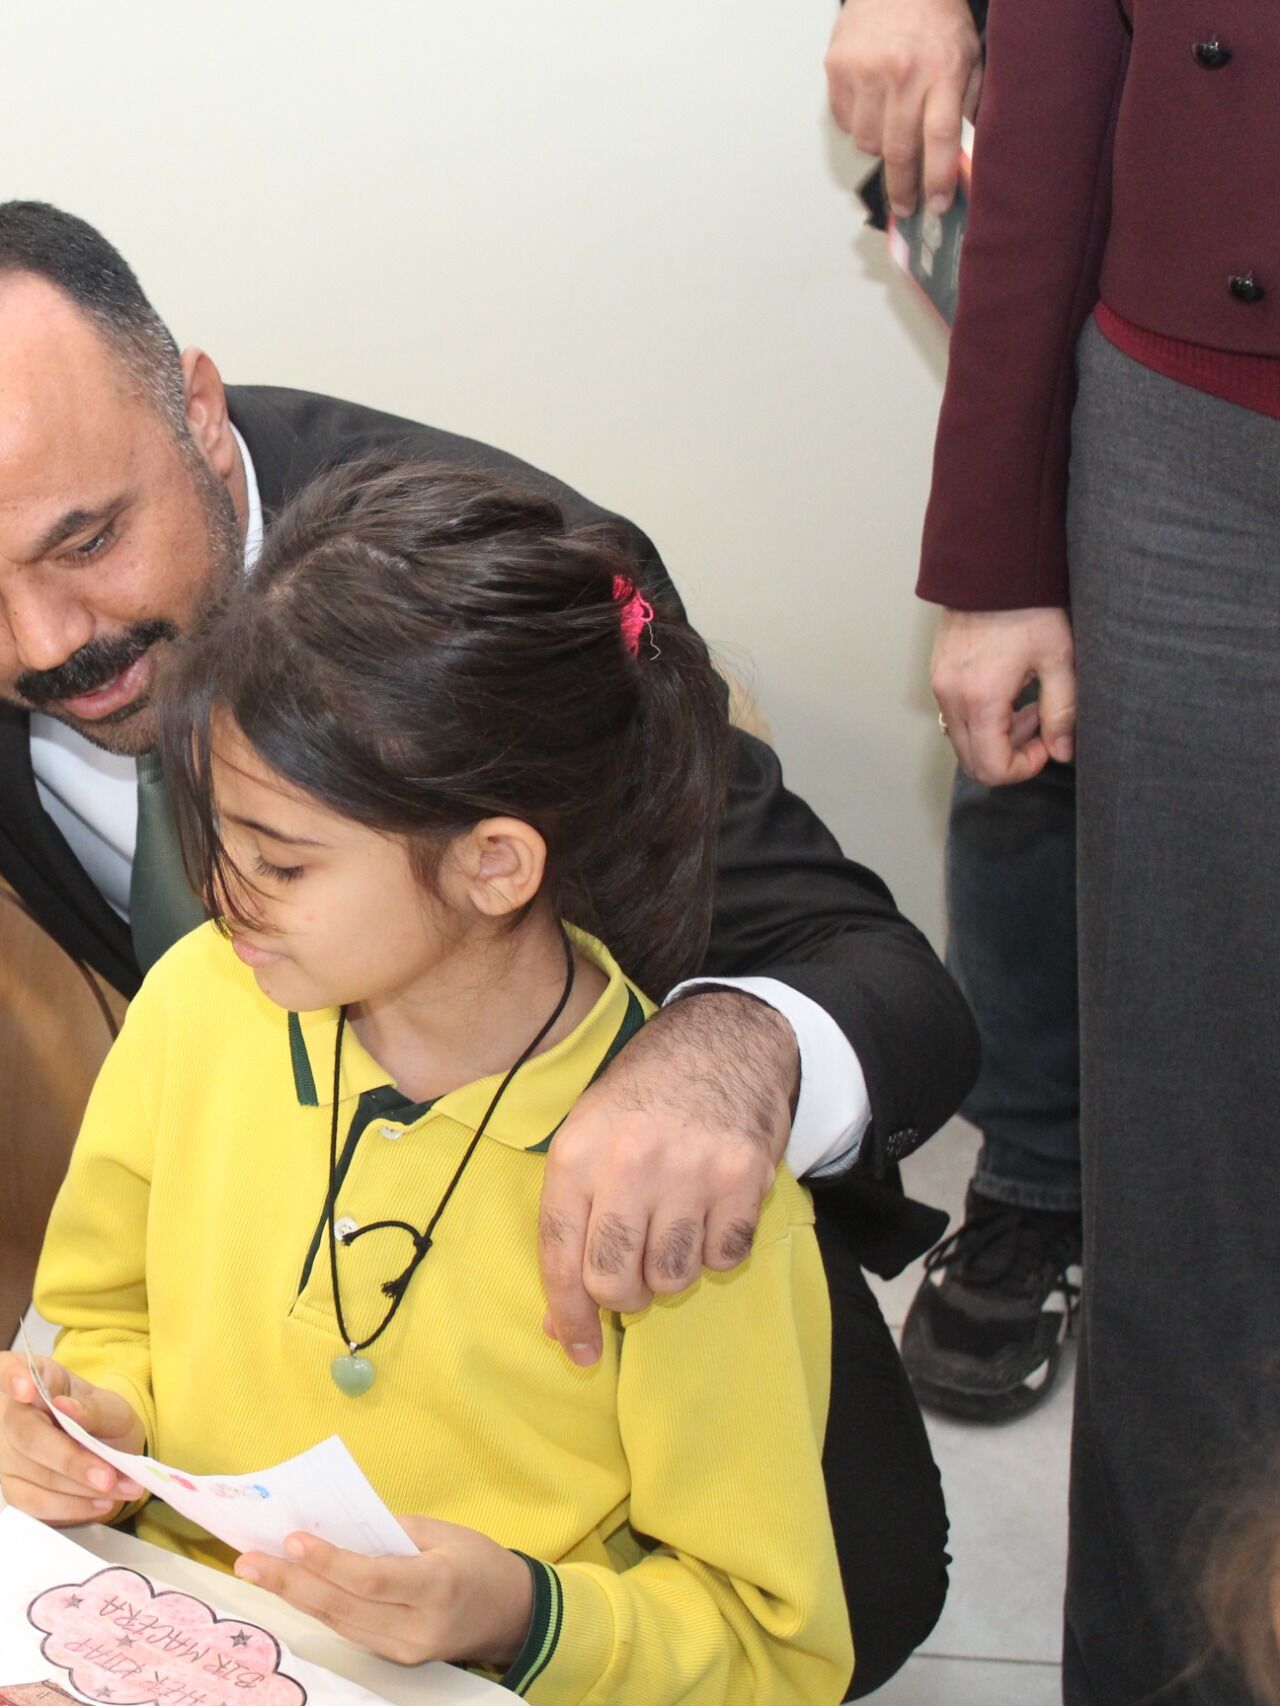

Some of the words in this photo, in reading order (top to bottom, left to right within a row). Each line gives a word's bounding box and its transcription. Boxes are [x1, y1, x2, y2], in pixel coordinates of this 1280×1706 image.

[99, 1596, 211, 1662] MACERA
[140, 1671, 207, 1704] HER
[204, 1654, 265, 1689] BIR
